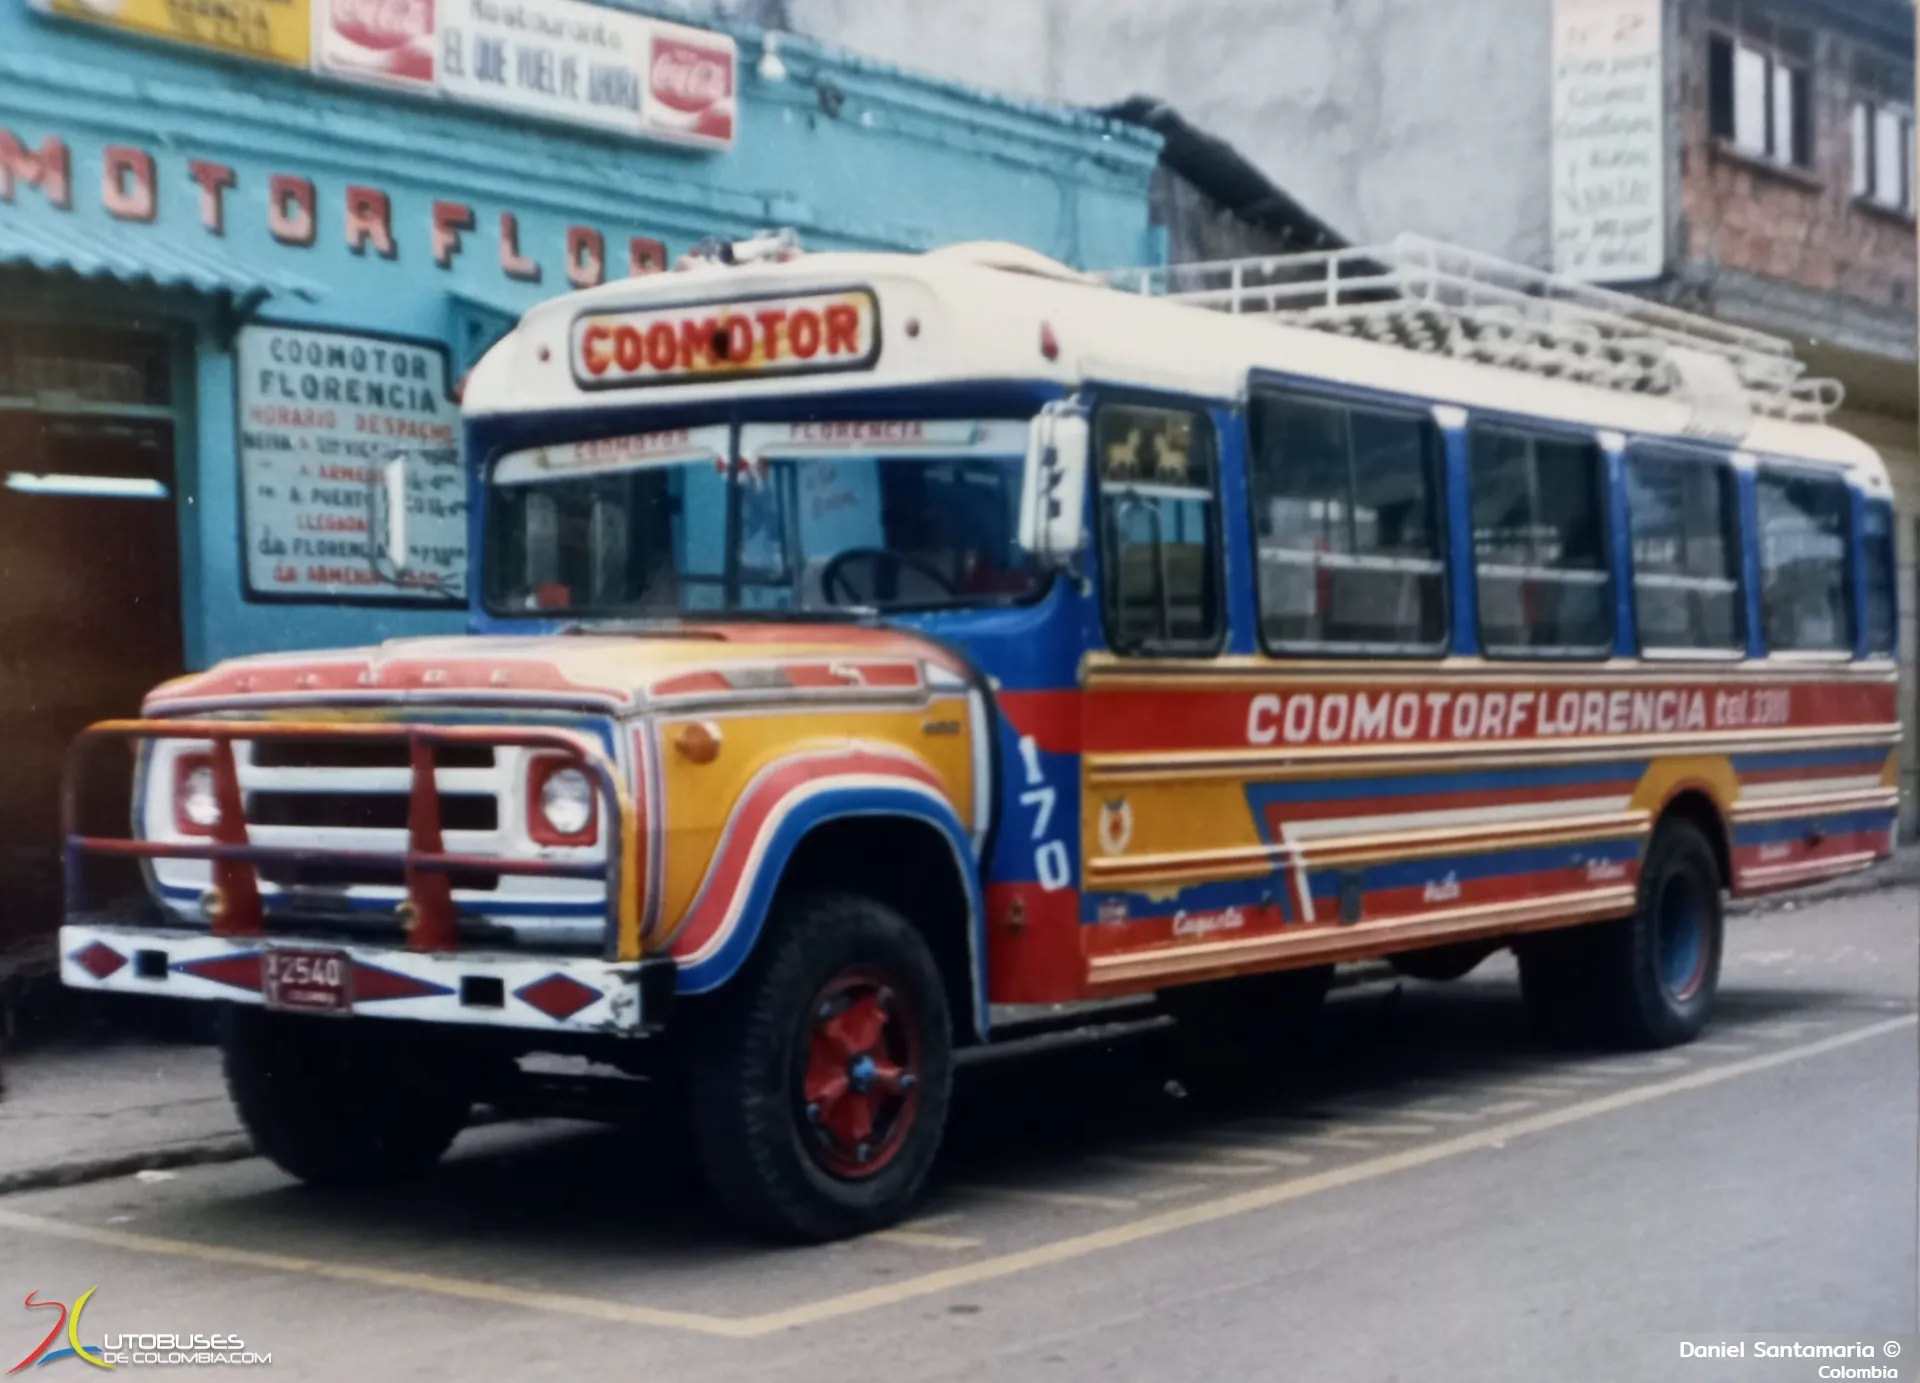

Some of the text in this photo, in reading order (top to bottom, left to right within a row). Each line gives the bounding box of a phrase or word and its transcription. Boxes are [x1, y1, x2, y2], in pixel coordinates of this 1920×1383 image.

[270, 336, 427, 380] COOMOTOR
[582, 304, 859, 374] COOMOTOR
[259, 369, 437, 412] FLORENCIA
[1246, 690, 1708, 745] COOMOTORFLORENCIA
[1018, 734, 1071, 890] 170
[281, 957, 340, 986] 2540
